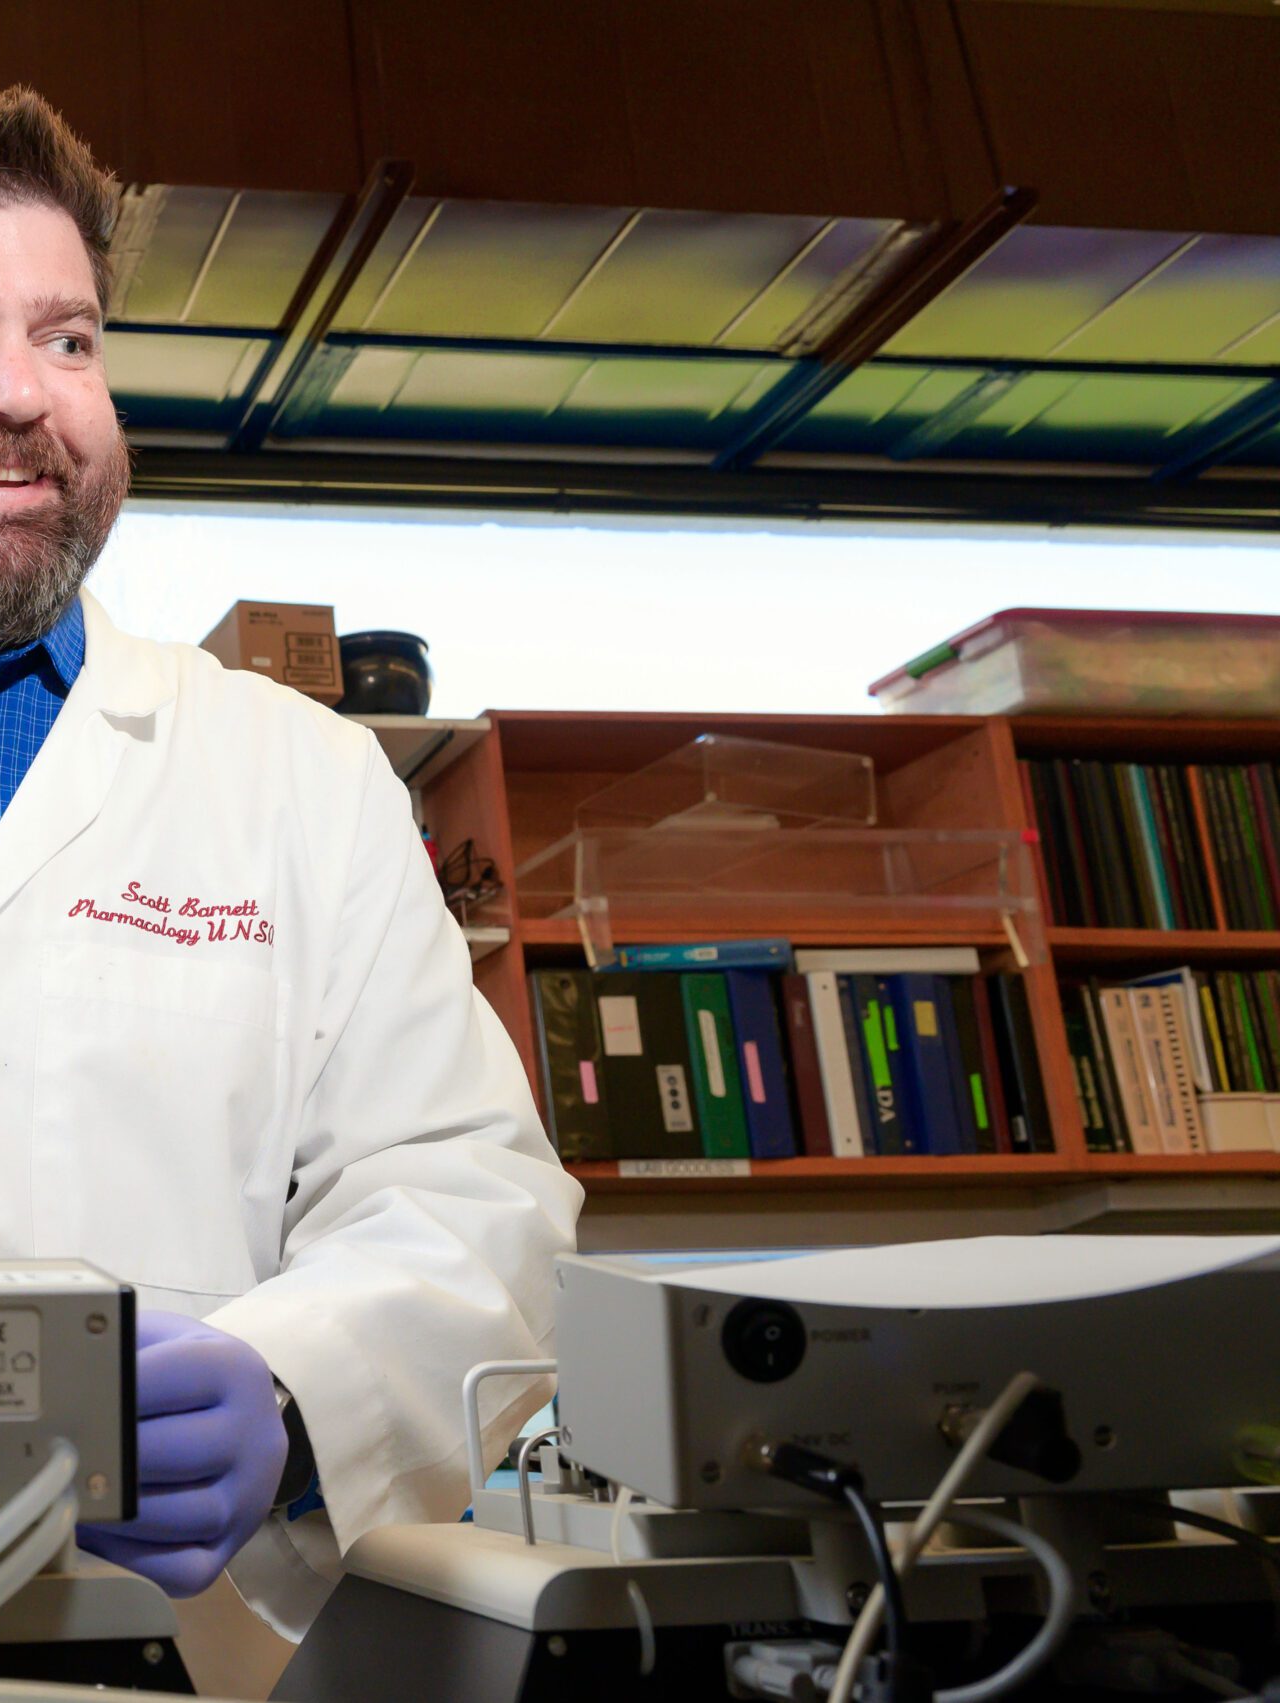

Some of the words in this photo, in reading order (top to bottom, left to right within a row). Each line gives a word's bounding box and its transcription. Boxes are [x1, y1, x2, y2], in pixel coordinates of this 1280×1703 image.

[121, 881, 172, 914] Scott
[178, 897, 260, 918] Barnett
[68, 898, 201, 946] Pharmacology
